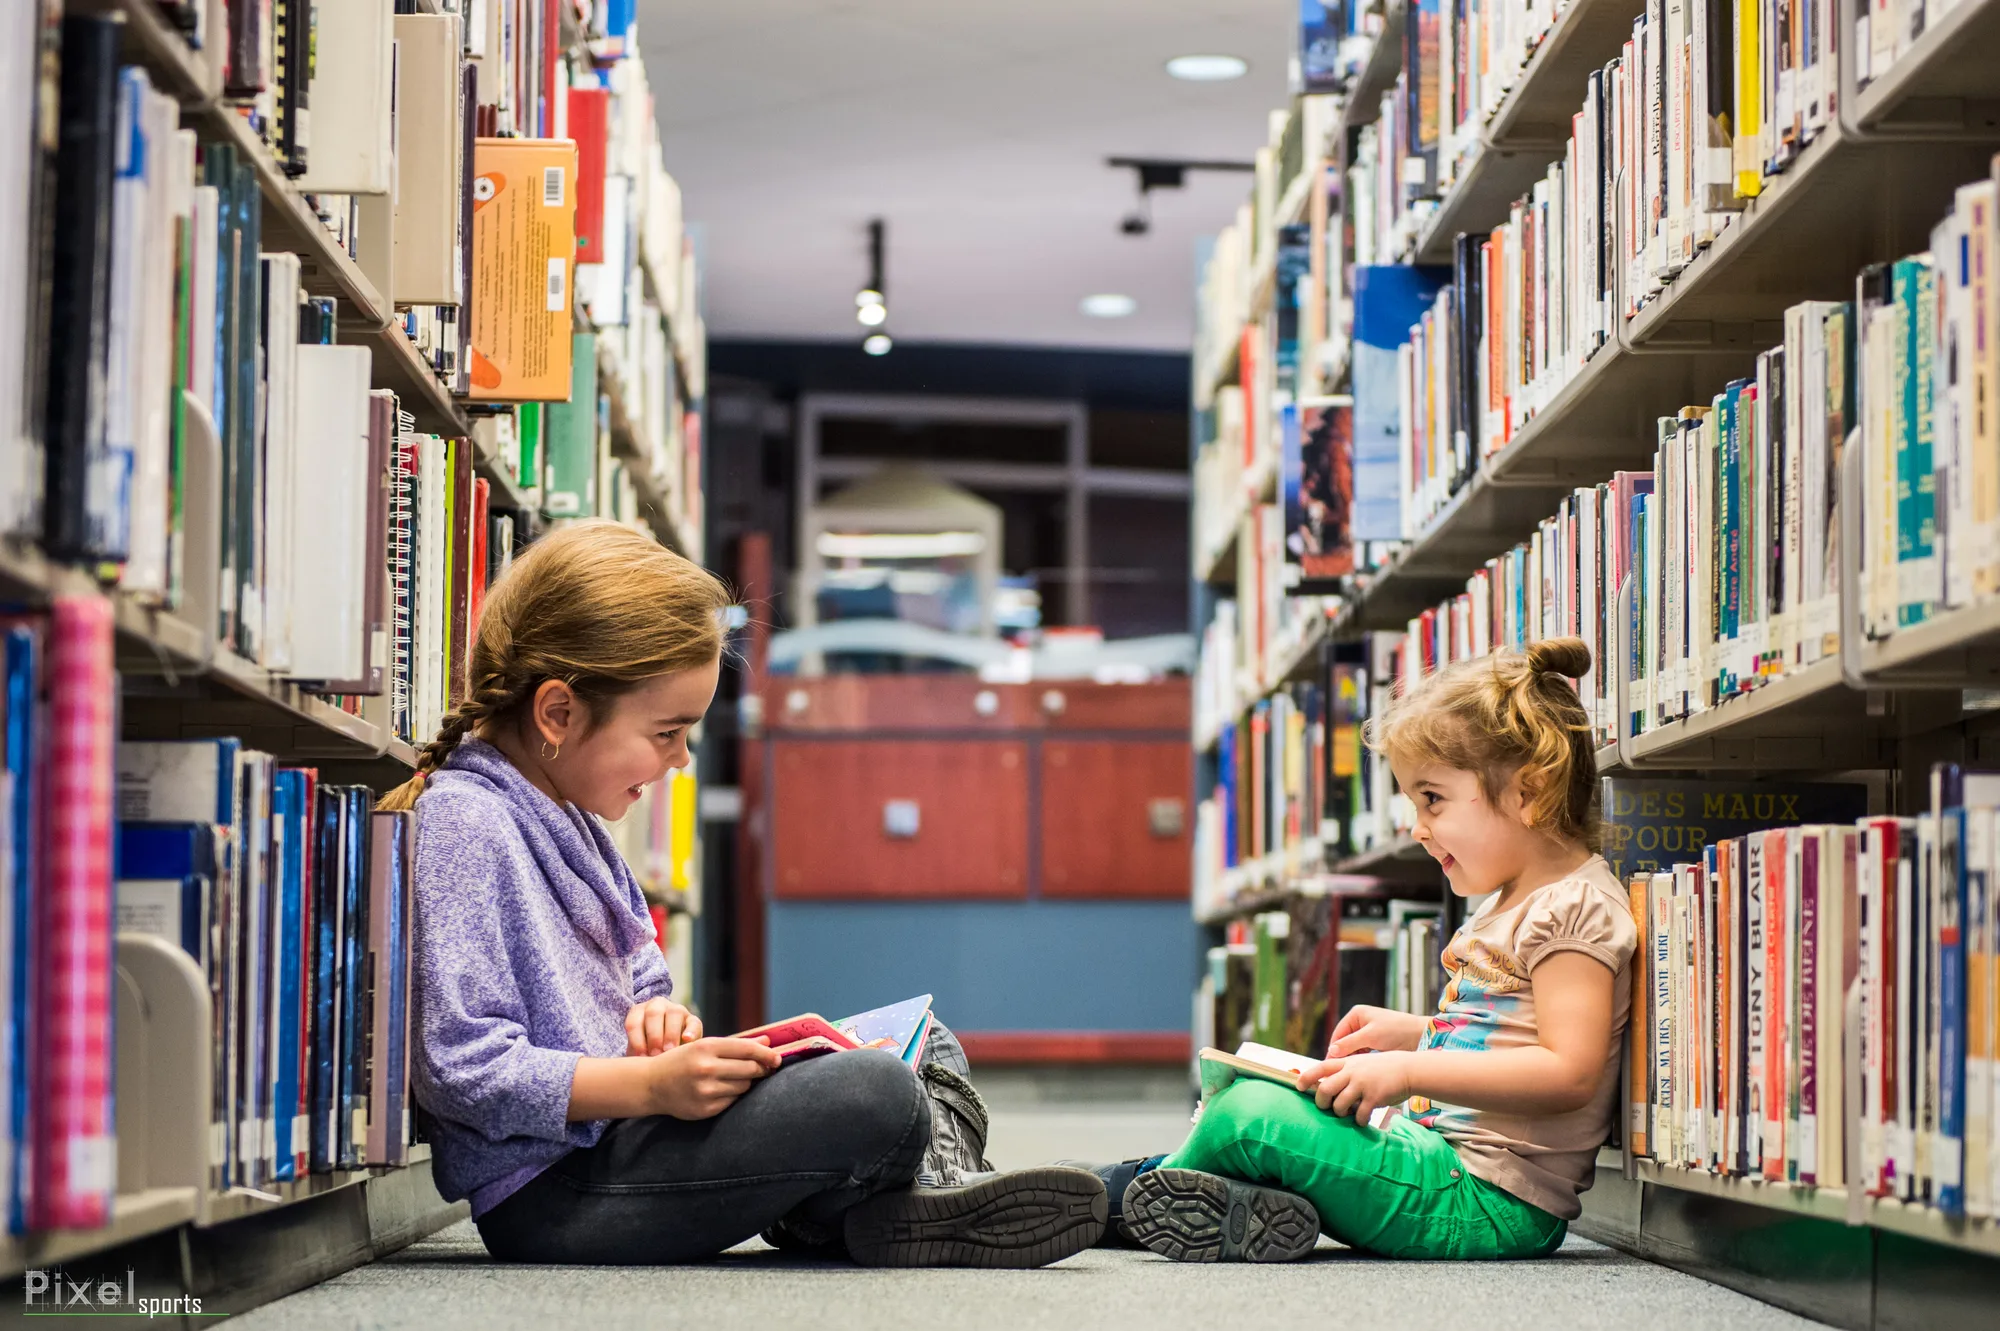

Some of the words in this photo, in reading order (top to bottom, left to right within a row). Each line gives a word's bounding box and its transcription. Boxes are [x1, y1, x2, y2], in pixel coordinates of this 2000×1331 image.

[1728, 529, 1738, 573] André
[1613, 790, 1685, 818] DES
[1703, 793, 1800, 821] MAUX
[1613, 825, 1708, 853] POUR
[1750, 845, 1762, 949] BLAIR
[1658, 968, 1670, 1008] SAINTE
[1750, 964, 1762, 1053] TONY
[1657, 1017, 1671, 1046] TRÈS
[1659, 1050, 1671, 1068] MA
